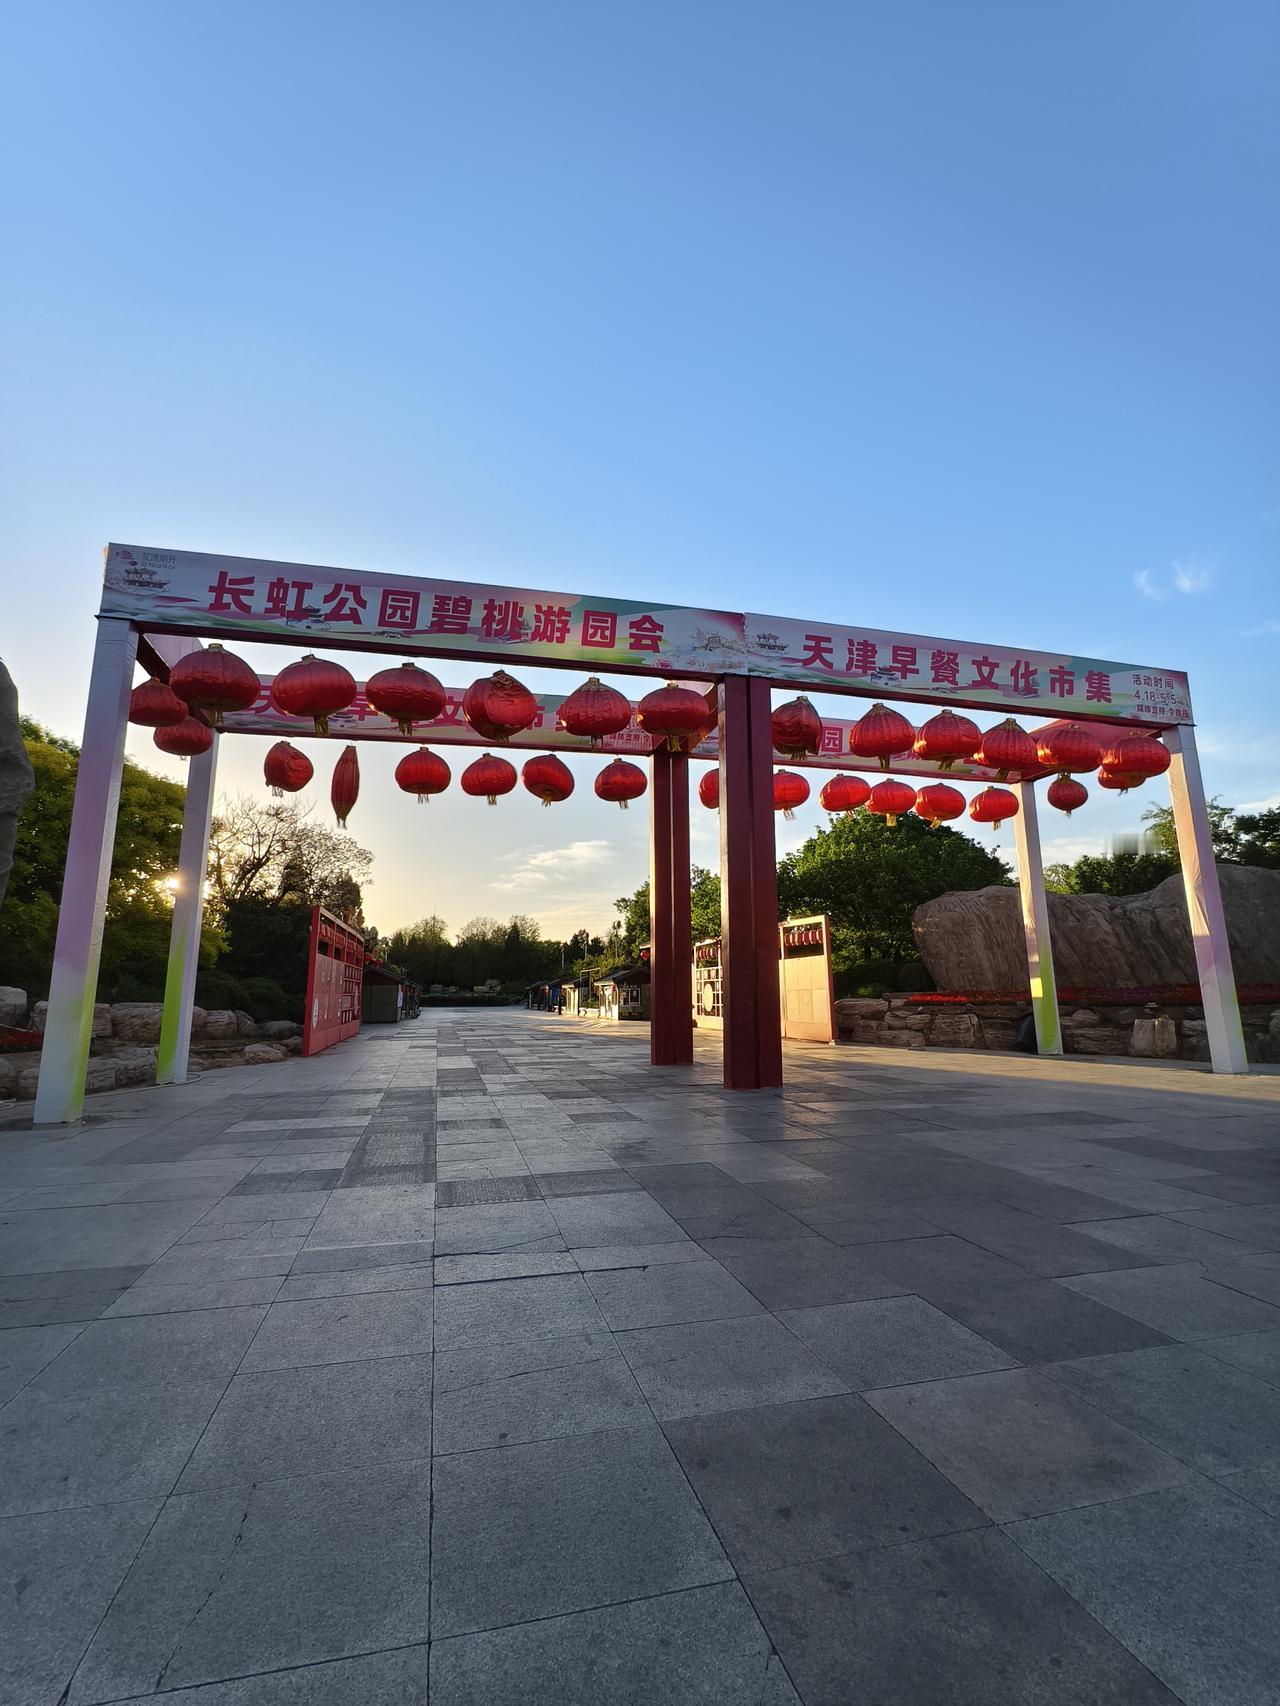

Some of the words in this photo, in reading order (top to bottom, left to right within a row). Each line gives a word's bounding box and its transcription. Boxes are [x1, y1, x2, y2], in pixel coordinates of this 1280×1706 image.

[208, 570, 664, 654] 长虹公园碧桃游园会
[801, 633, 1112, 704] 天津早餐文化市集
[1131, 673, 1174, 690] 活动时间
[1134, 689, 1177, 705] 4.18-5.5
